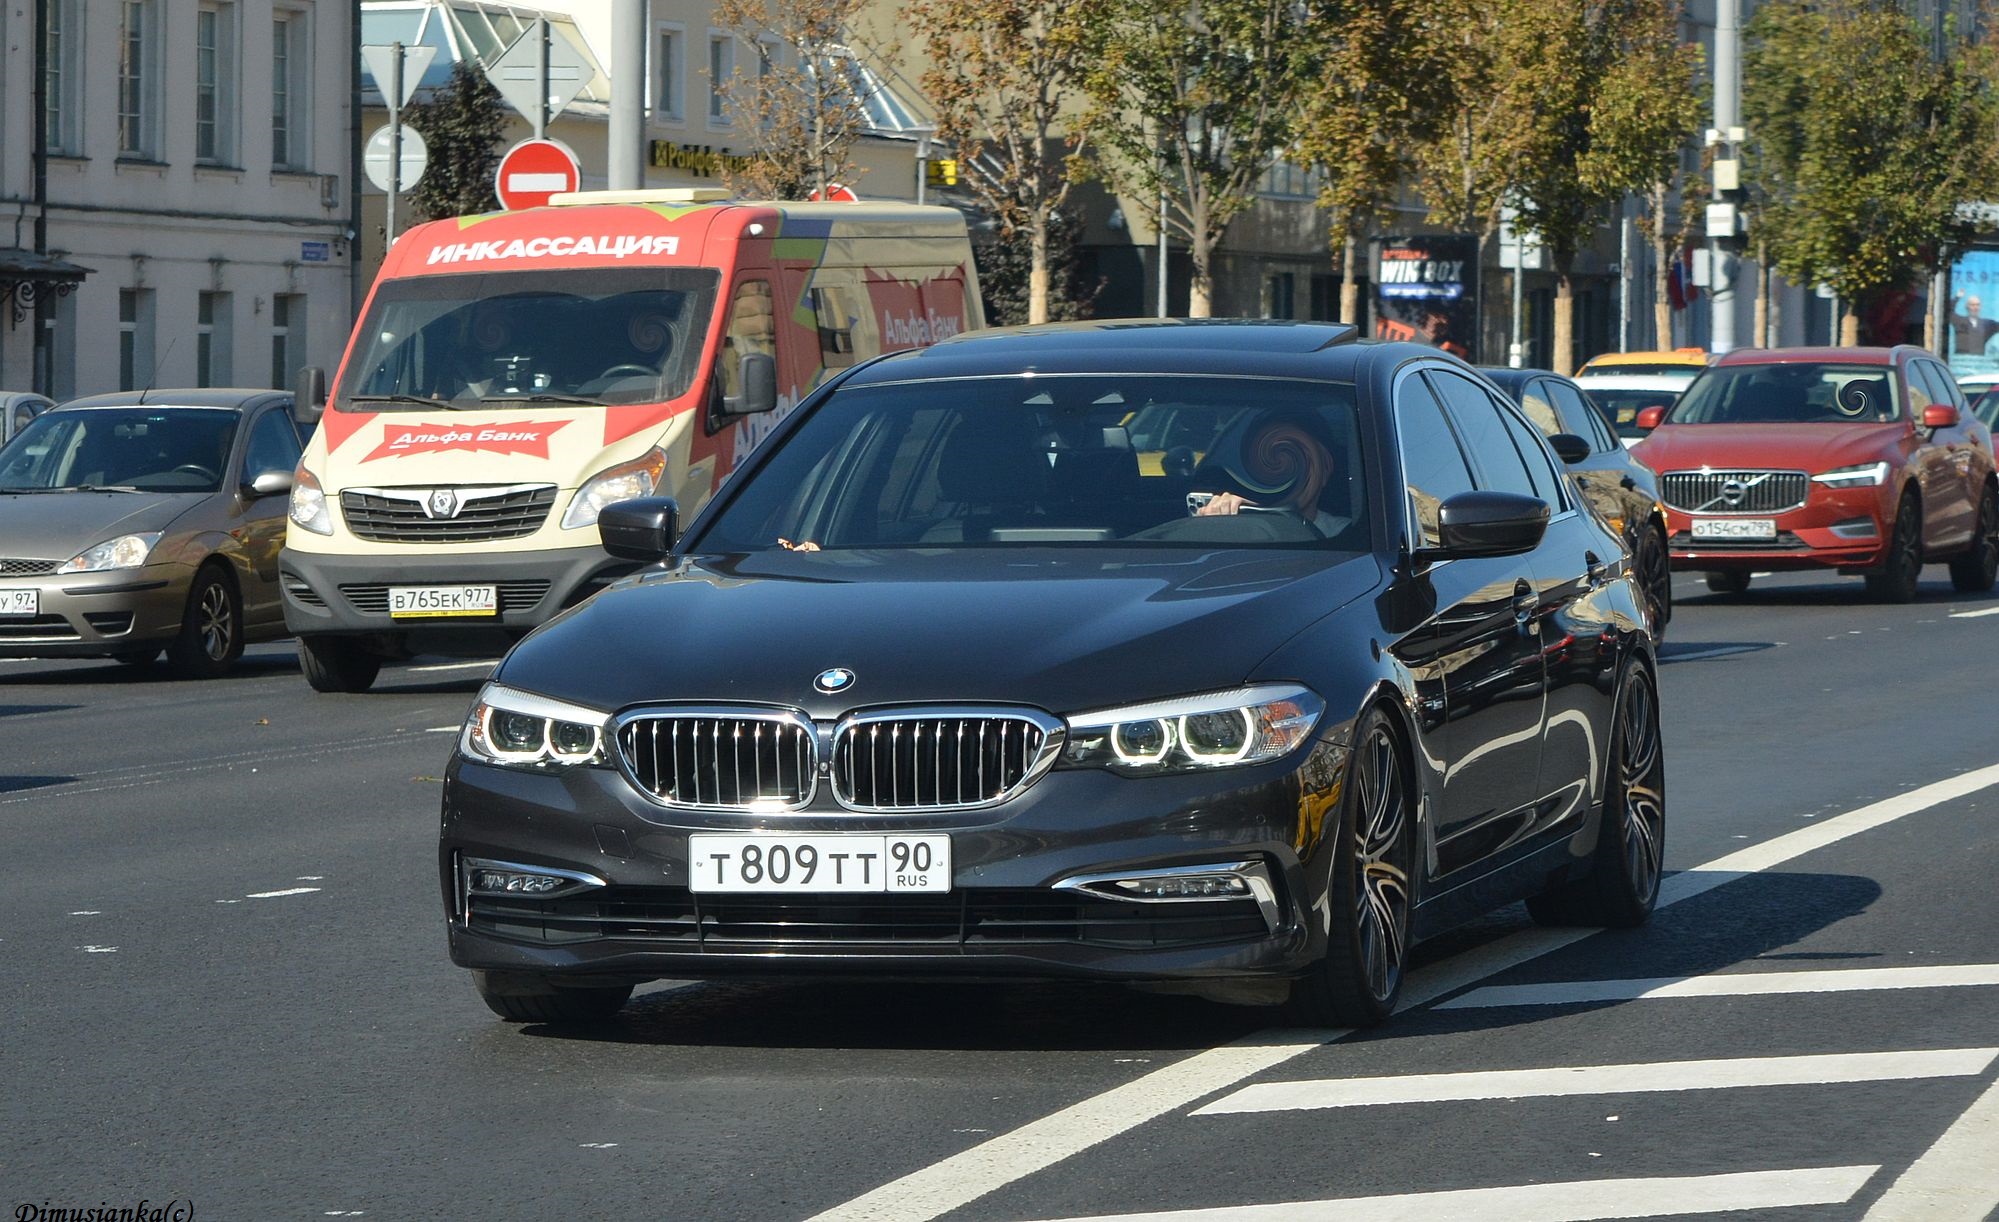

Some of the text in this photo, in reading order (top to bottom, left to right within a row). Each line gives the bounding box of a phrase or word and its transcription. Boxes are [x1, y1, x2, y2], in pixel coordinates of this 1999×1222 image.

[426, 236, 679, 264] ИНКАССАЦИЯ
[884, 309, 929, 348] Альфа
[390, 430, 540, 447] Альфа Банк
[395, 588, 491, 609] В765ЕК 977
[891, 841, 932, 873] 90
[897, 875, 928, 887] RUS
